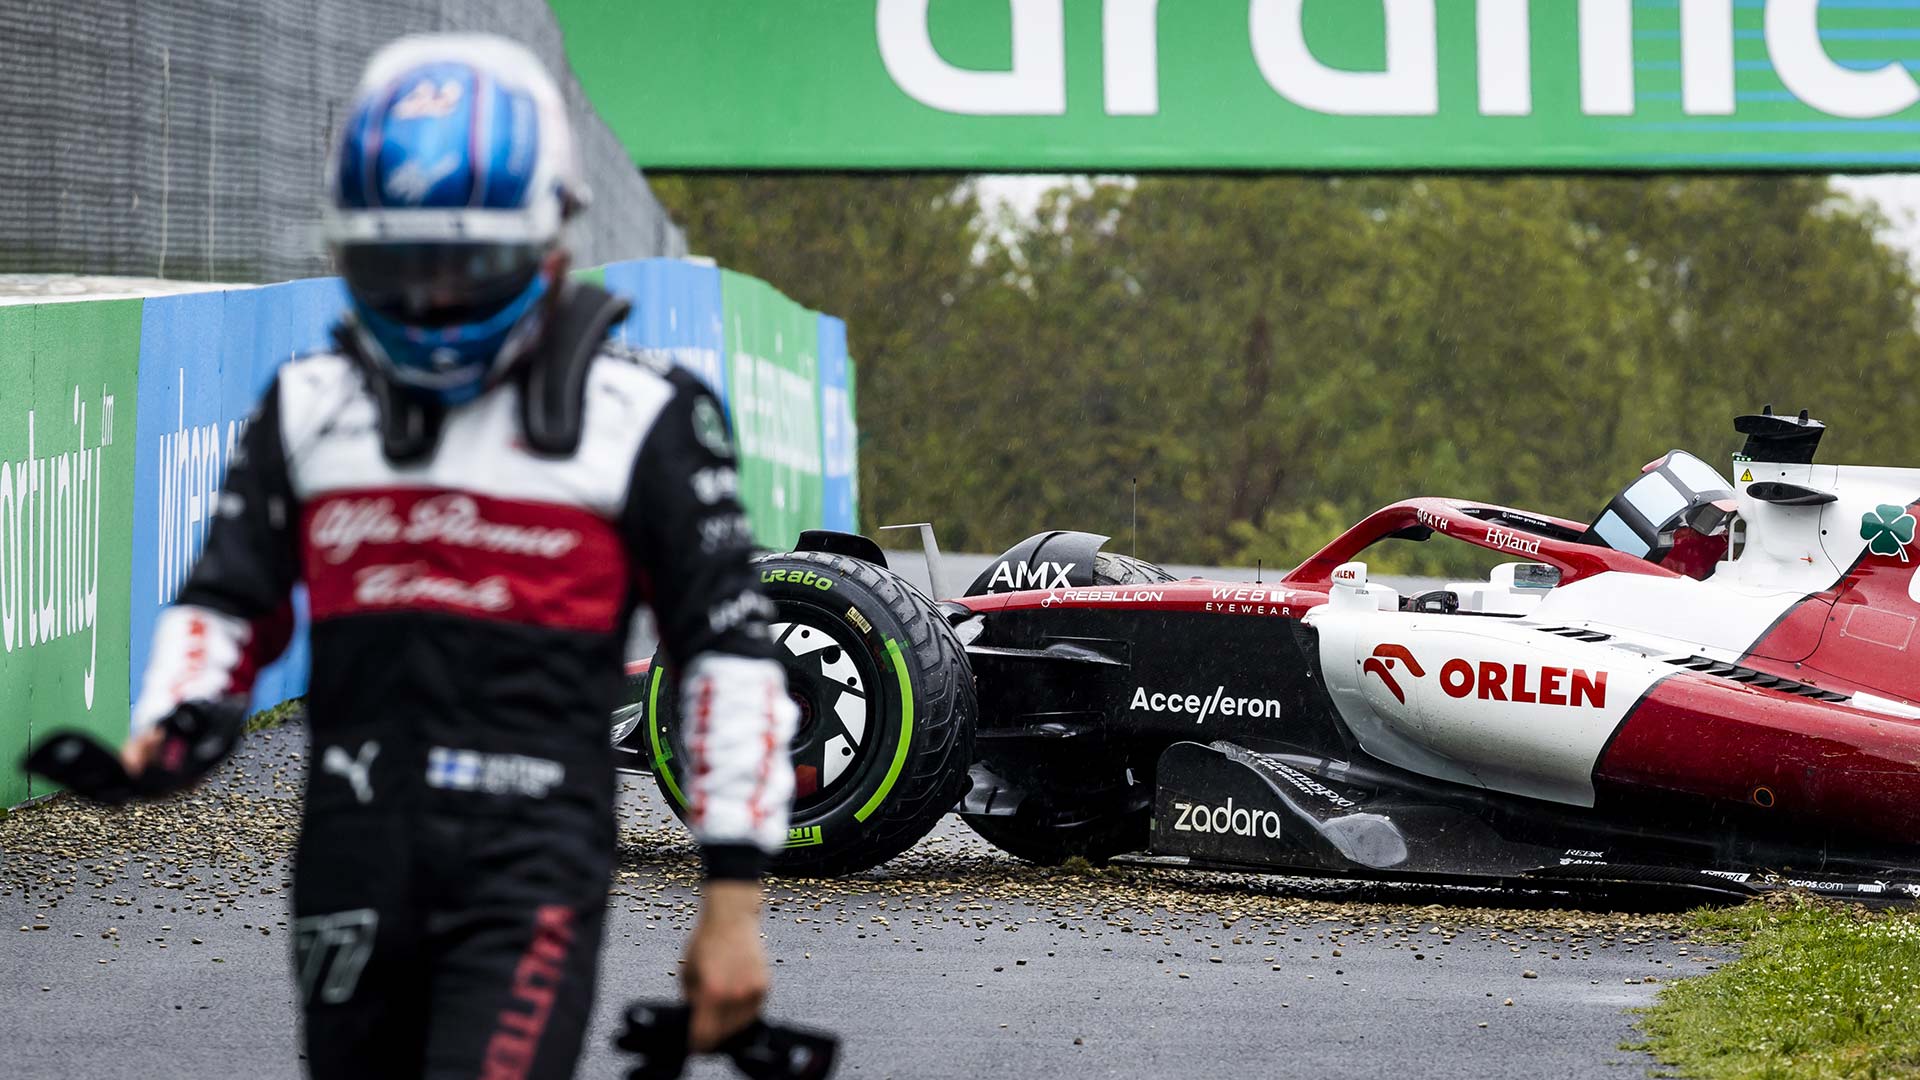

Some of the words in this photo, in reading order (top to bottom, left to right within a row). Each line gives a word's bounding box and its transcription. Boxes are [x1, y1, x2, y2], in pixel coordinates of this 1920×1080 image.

[1485, 527, 1541, 555] Hyland
[987, 560, 1075, 588] AMX
[1063, 591, 1163, 602] REBELLION
[1212, 587, 1266, 602] WEB
[1205, 602, 1290, 615] EYEWEAR
[1439, 658, 1608, 709] ORLEN
[1174, 797, 1280, 839] zadara
[1780, 877, 1844, 891] ocios.com
